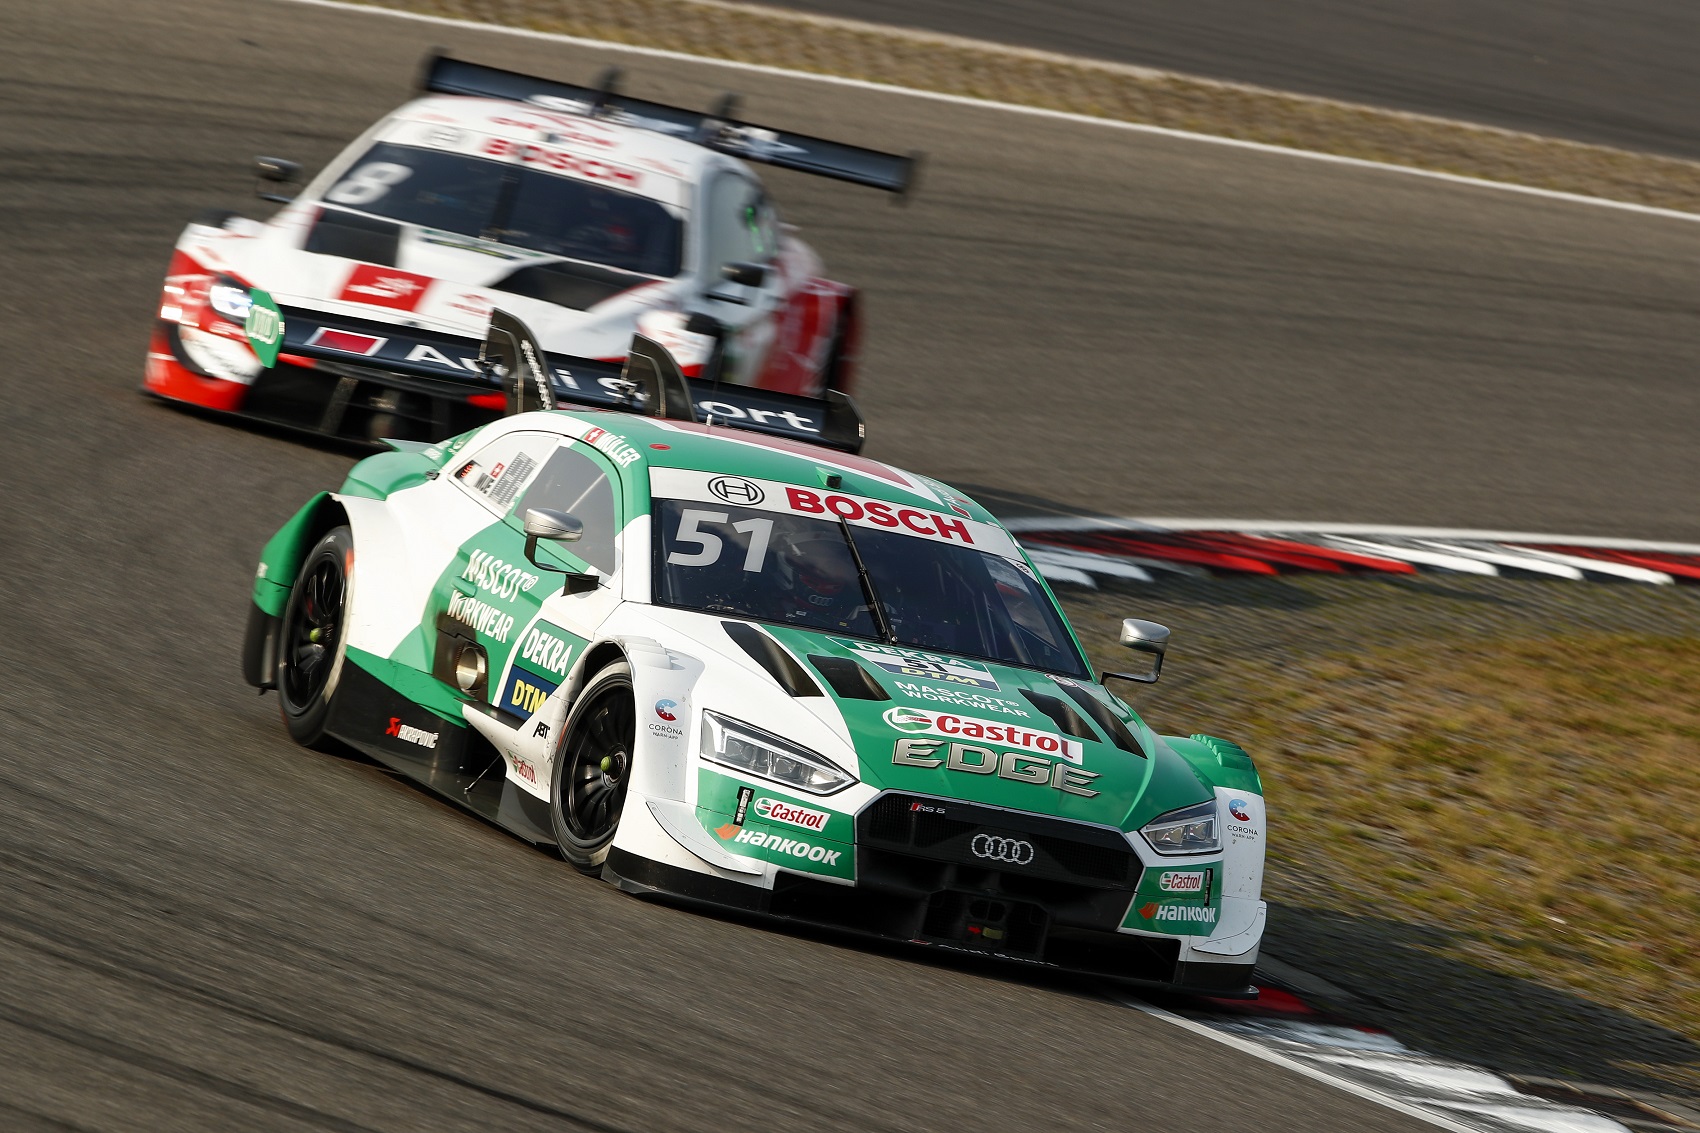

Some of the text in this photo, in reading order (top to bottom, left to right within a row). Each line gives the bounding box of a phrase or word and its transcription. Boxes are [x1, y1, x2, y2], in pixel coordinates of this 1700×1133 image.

[326, 162, 414, 205] 8
[597, 432, 642, 468] MÜLLER
[785, 487, 975, 545] BOSCH
[667, 508, 774, 573] 51
[447, 590, 514, 643] WORKWEAR
[522, 628, 573, 676] DEKRA
[854, 641, 974, 670] DEKRA
[903, 658, 948, 673] 51
[901, 667, 980, 686] DTM
[511, 679, 548, 713] DTM
[902, 690, 1032, 719] WORKWEAR
[533, 720, 551, 739] ABT
[649, 724, 684, 736] CORONA
[936, 715, 1075, 760] Castrol
[892, 738, 1103, 798] EDGE
[771, 803, 824, 829] Castrol
[1227, 825, 1259, 836] CORONA
[1170, 874, 1202, 889] Castrol
